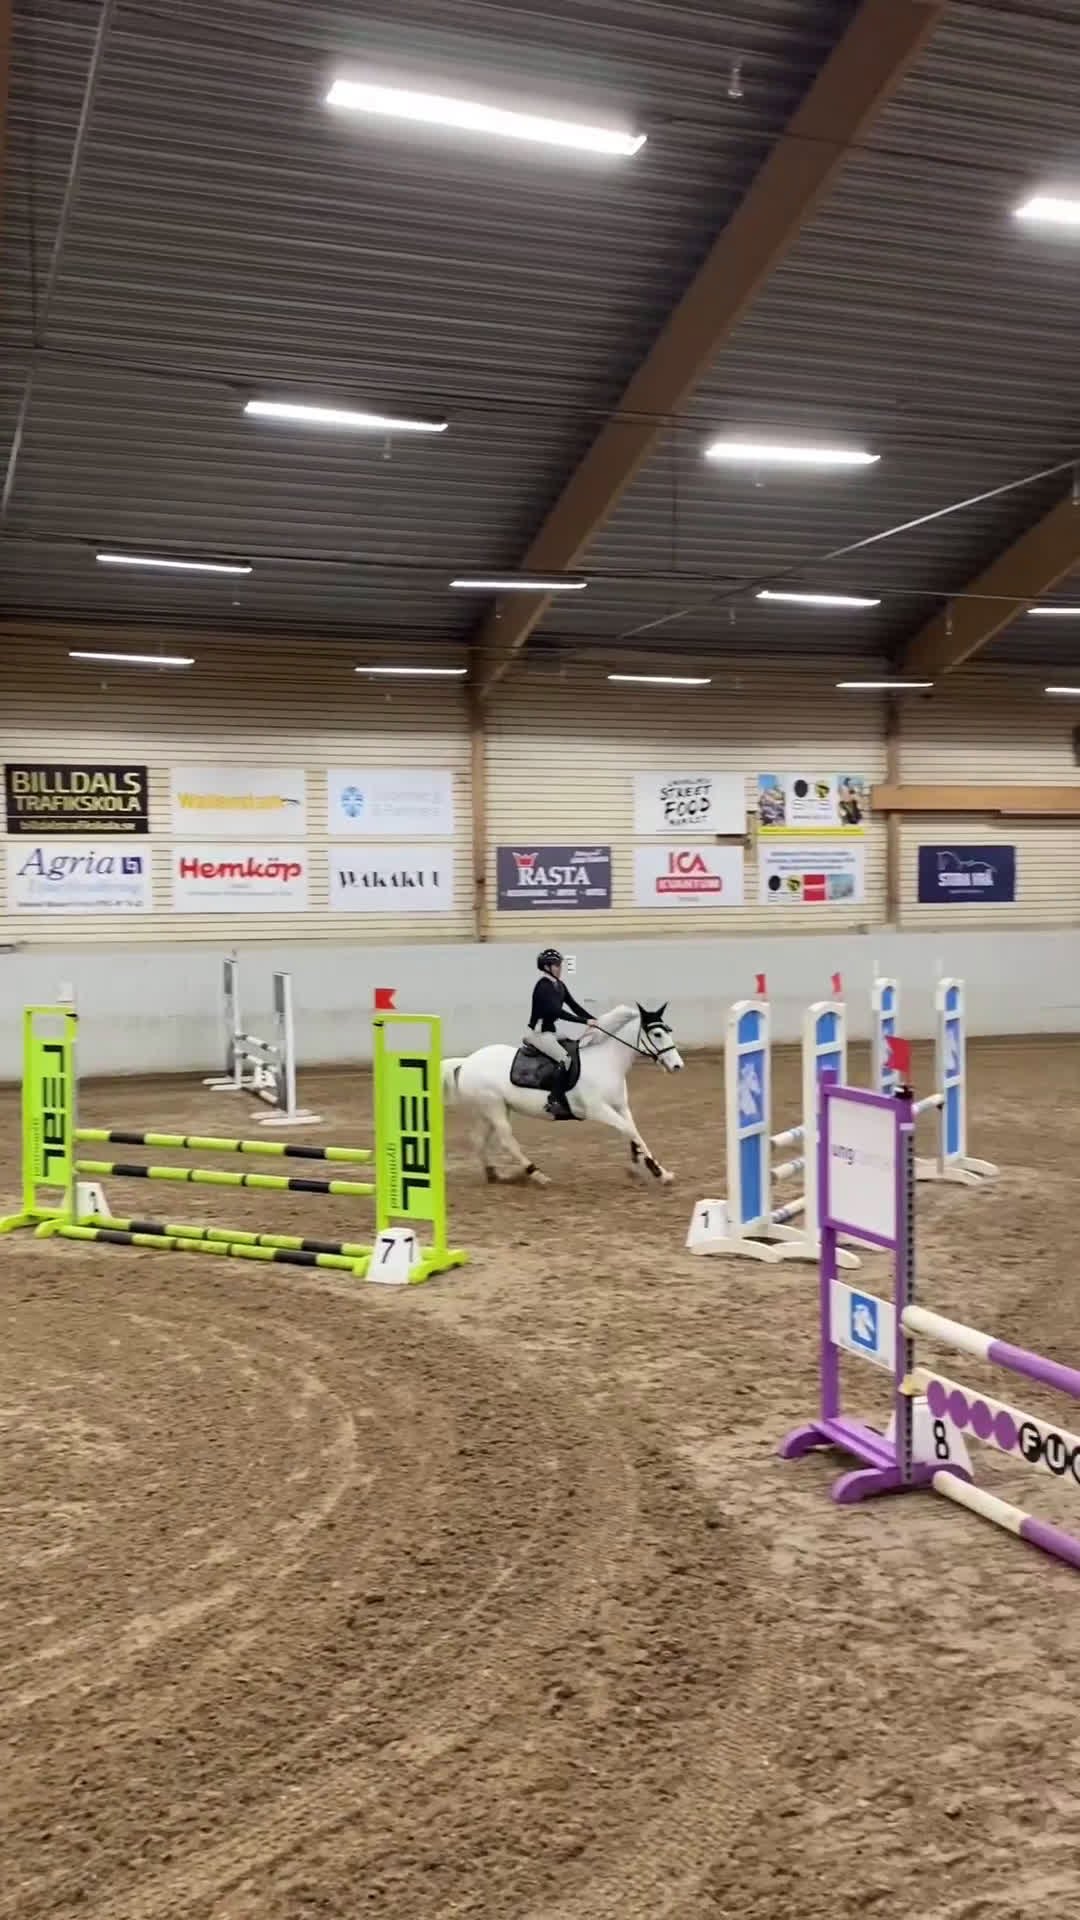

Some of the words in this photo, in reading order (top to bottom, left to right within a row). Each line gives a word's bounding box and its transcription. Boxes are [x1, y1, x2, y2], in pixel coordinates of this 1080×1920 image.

[11, 771, 141, 794] BILLDALS
[660, 785, 712, 800] STREET
[15, 795, 141, 811] TRAFIKSKOLA
[664, 797, 711, 817] FOOD
[17, 847, 114, 881] Agria
[179, 856, 302, 882] Hemköp
[668, 851, 707, 873] ICA
[517, 866, 591, 887] RASTA
[932, 1418, 950, 1461] 8
